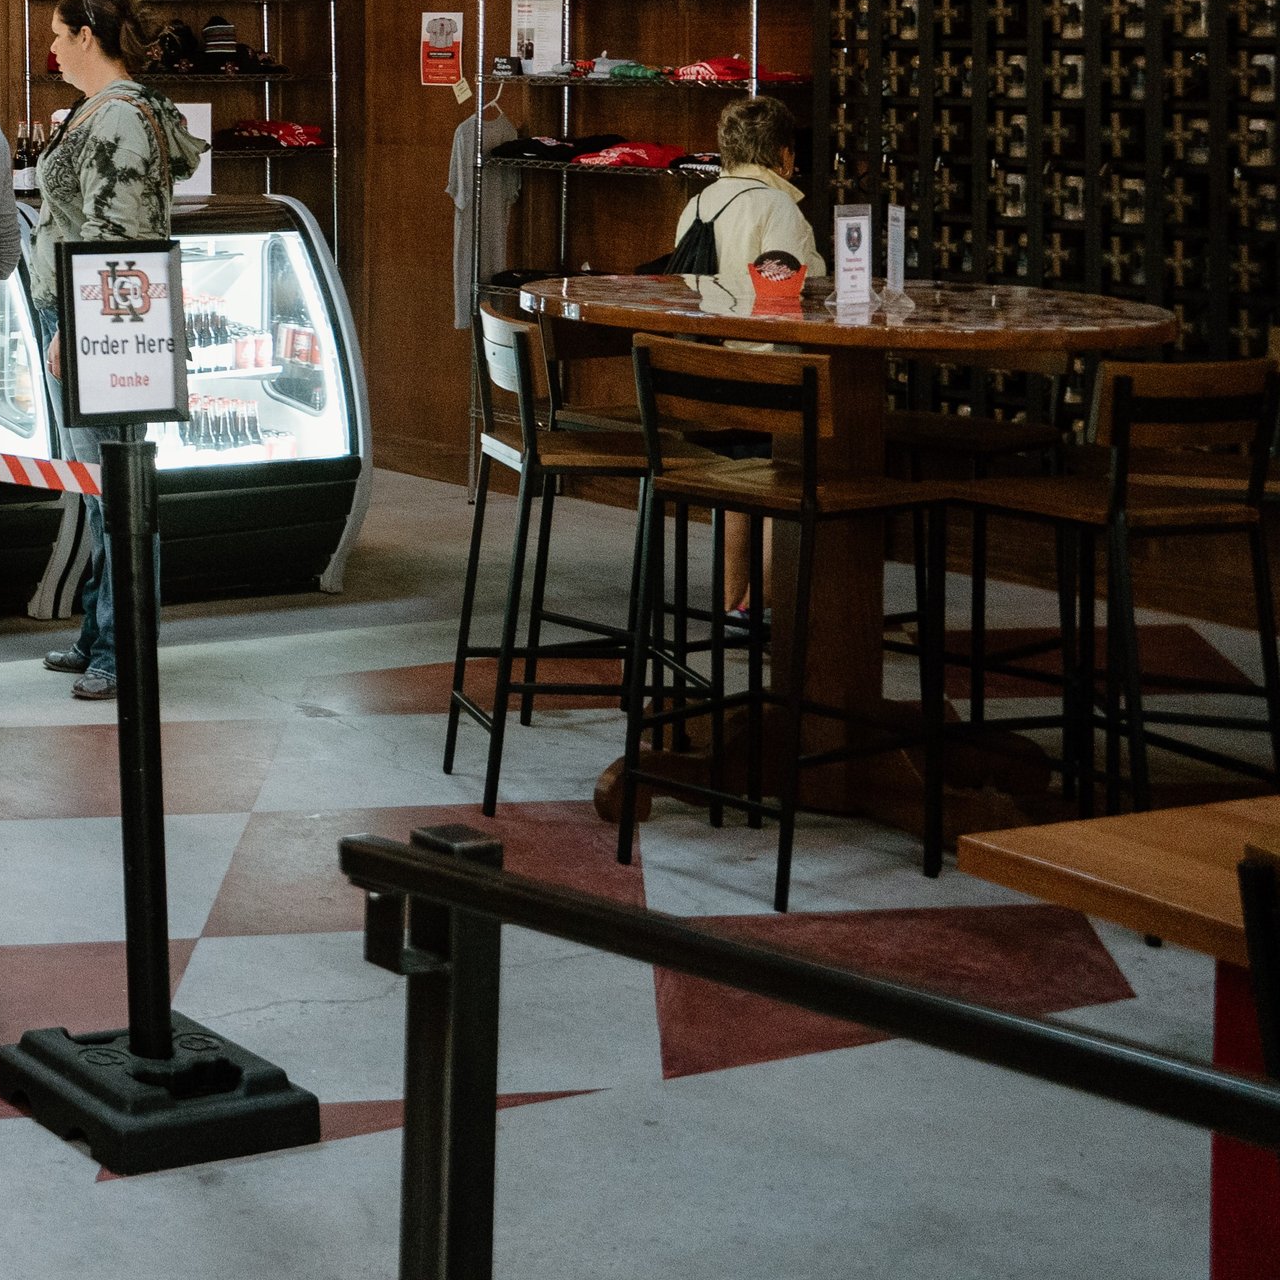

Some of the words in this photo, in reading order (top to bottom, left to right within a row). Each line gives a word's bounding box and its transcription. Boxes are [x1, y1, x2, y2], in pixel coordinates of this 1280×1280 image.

[80, 335, 129, 356] Order
[135, 335, 175, 355] Here
[109, 372, 150, 389] Danke
